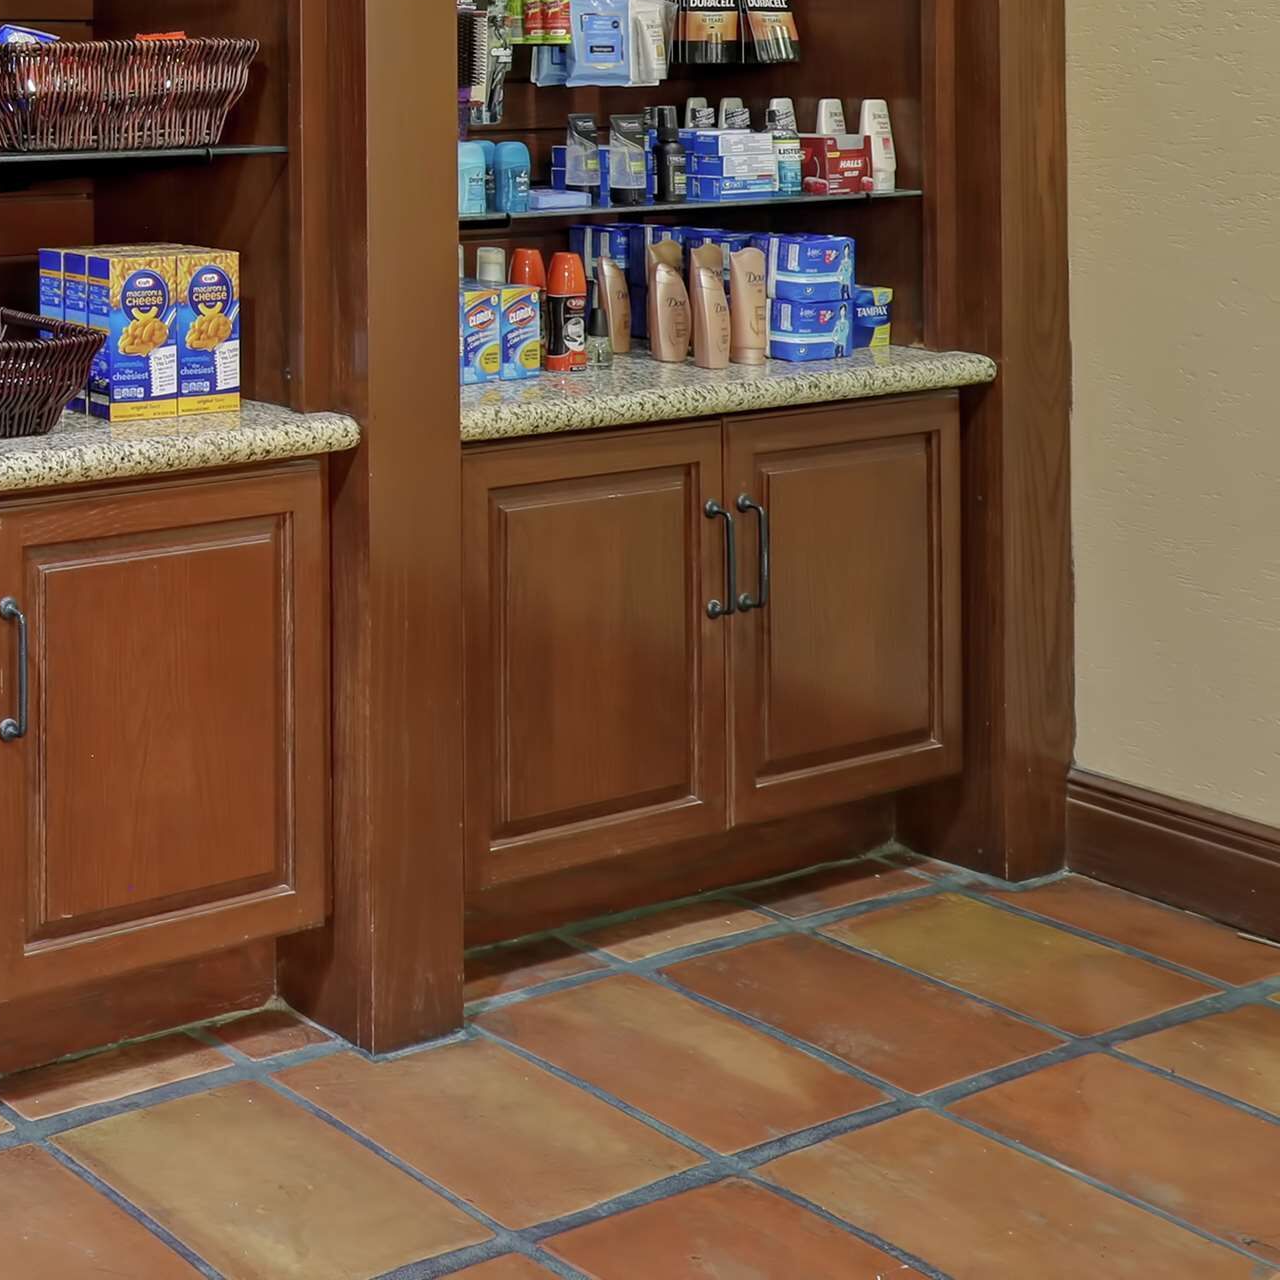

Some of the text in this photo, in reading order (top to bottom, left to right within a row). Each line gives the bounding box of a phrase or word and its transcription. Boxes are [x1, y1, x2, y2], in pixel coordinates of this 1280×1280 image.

[840, 160, 862, 168] HALLS
[126, 290, 156, 298] macaroni
[857, 305, 888, 317] TAMPAX
[180, 366, 214, 375] cheesiest
[112, 372, 149, 381] cheesiest
